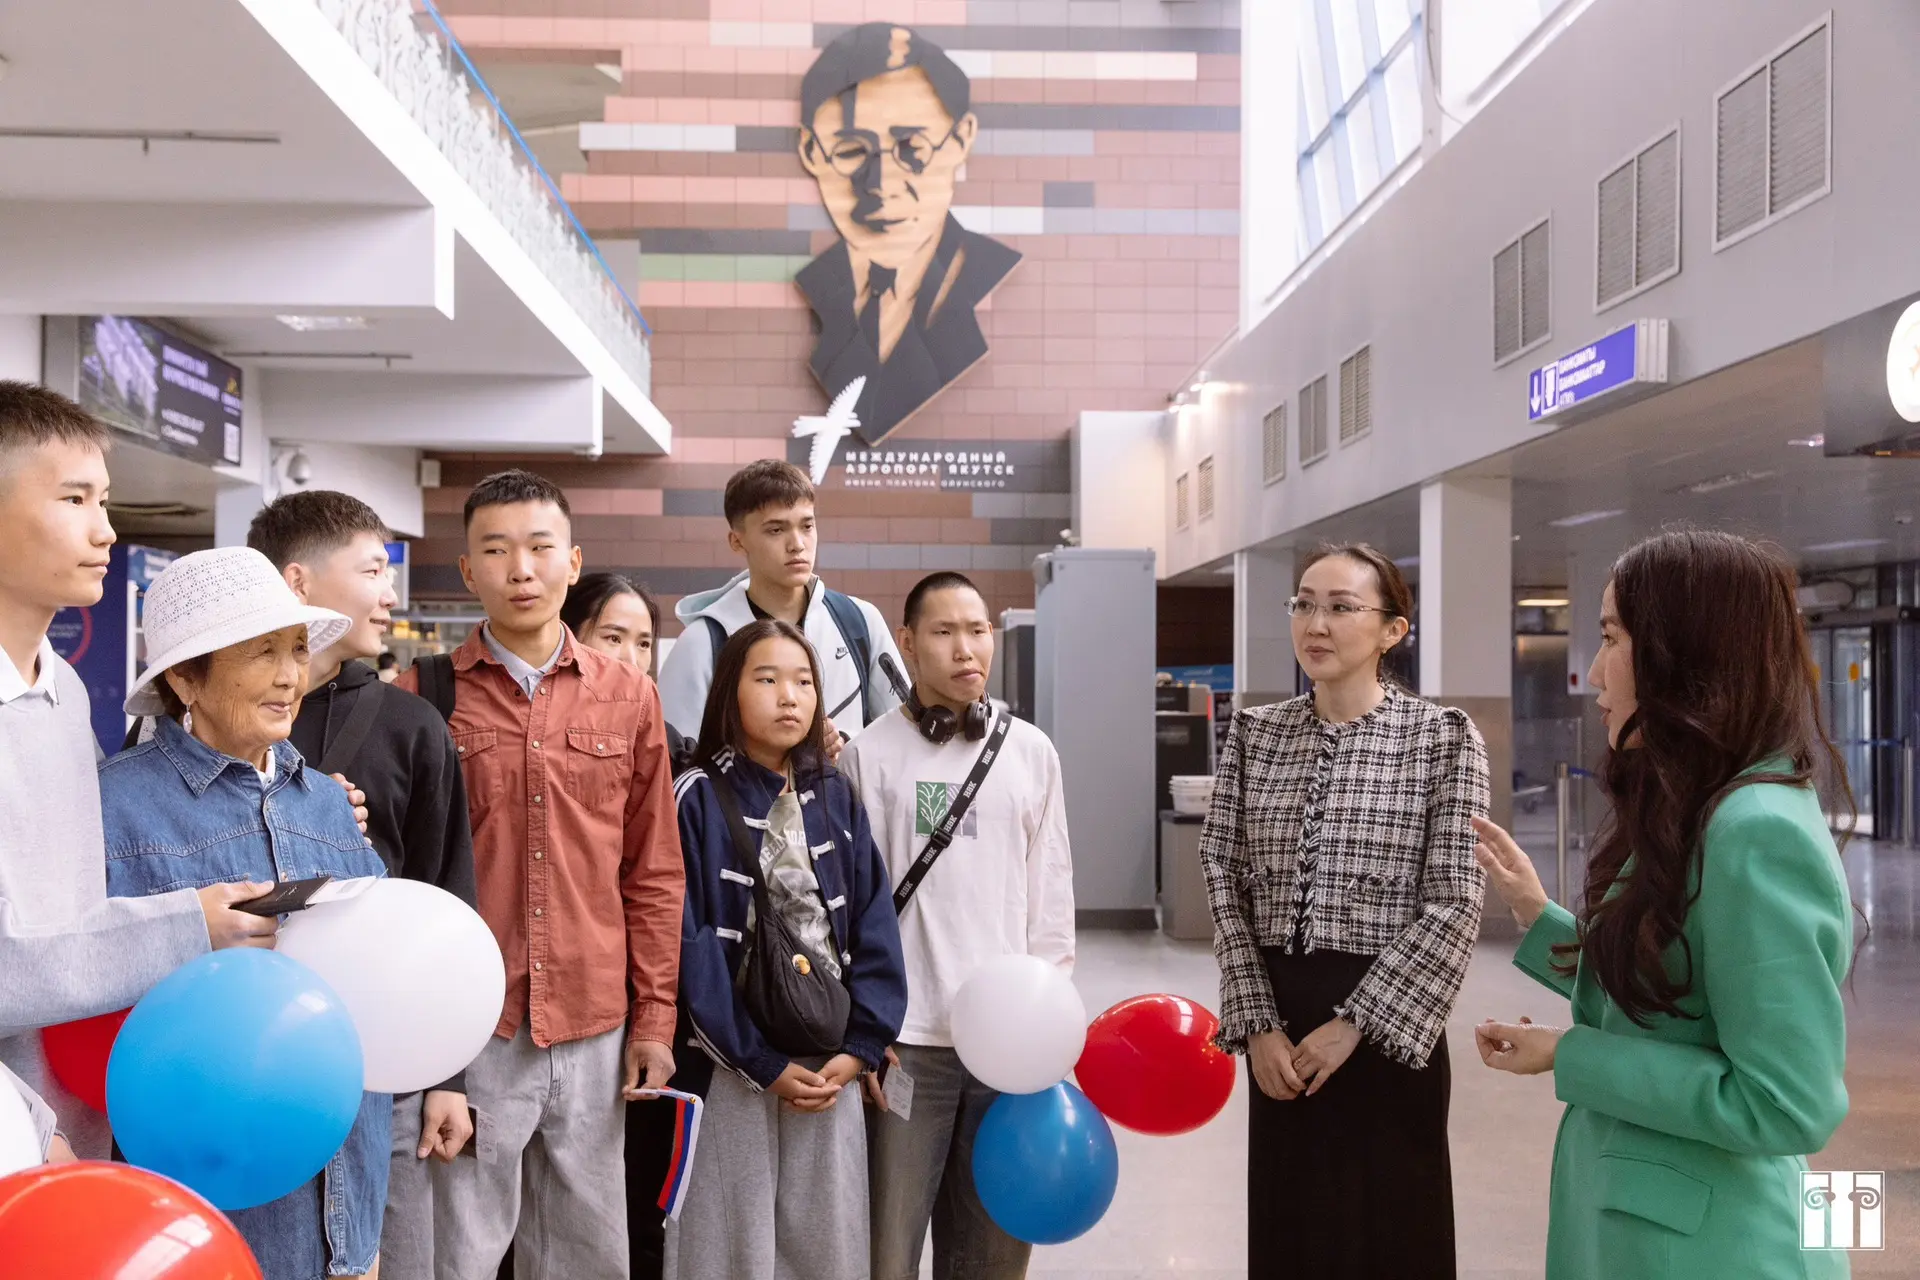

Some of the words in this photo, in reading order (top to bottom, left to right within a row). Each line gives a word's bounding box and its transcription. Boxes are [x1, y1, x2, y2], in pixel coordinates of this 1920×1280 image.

[845, 451, 1006, 464] МЕЖДУНАРОДНЫЙ
[845, 463, 939, 475] АЭРОПОРТ
[948, 464, 1015, 476] ЯКУТСК
[886, 479, 937, 487] ПЛАТОНА
[943, 814, 958, 832] HBK
[922, 847, 937, 865] HBK
[899, 880, 914, 898] HBK
